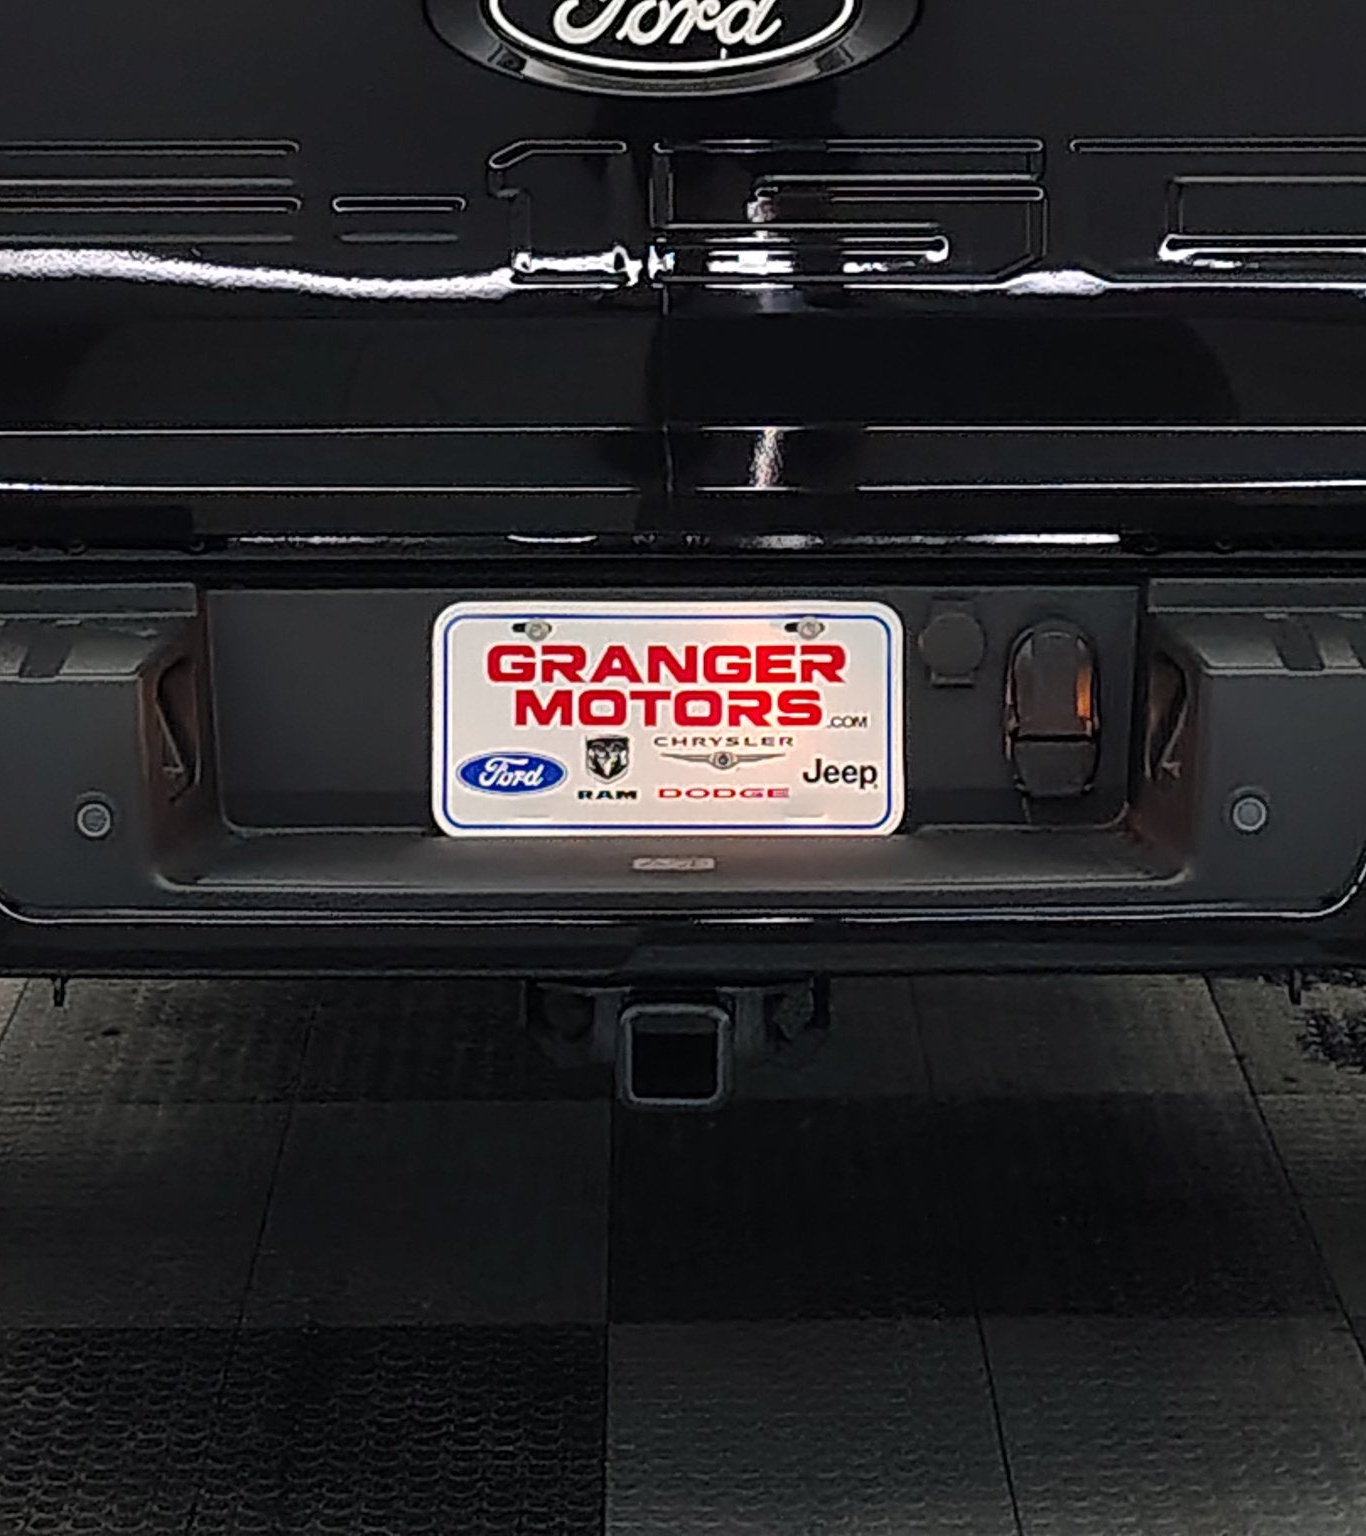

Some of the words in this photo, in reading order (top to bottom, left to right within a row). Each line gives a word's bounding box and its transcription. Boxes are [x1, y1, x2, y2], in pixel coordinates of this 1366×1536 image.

[486, 644, 847, 684] GRANGER
[513, 689, 824, 728] MOTORS
[653, 735, 795, 747] CHRYSLER
[478, 756, 544, 789] Ford
[802, 758, 878, 789] Jeep
[577, 788, 638, 800] RAM
[657, 787, 791, 799] DODGE
